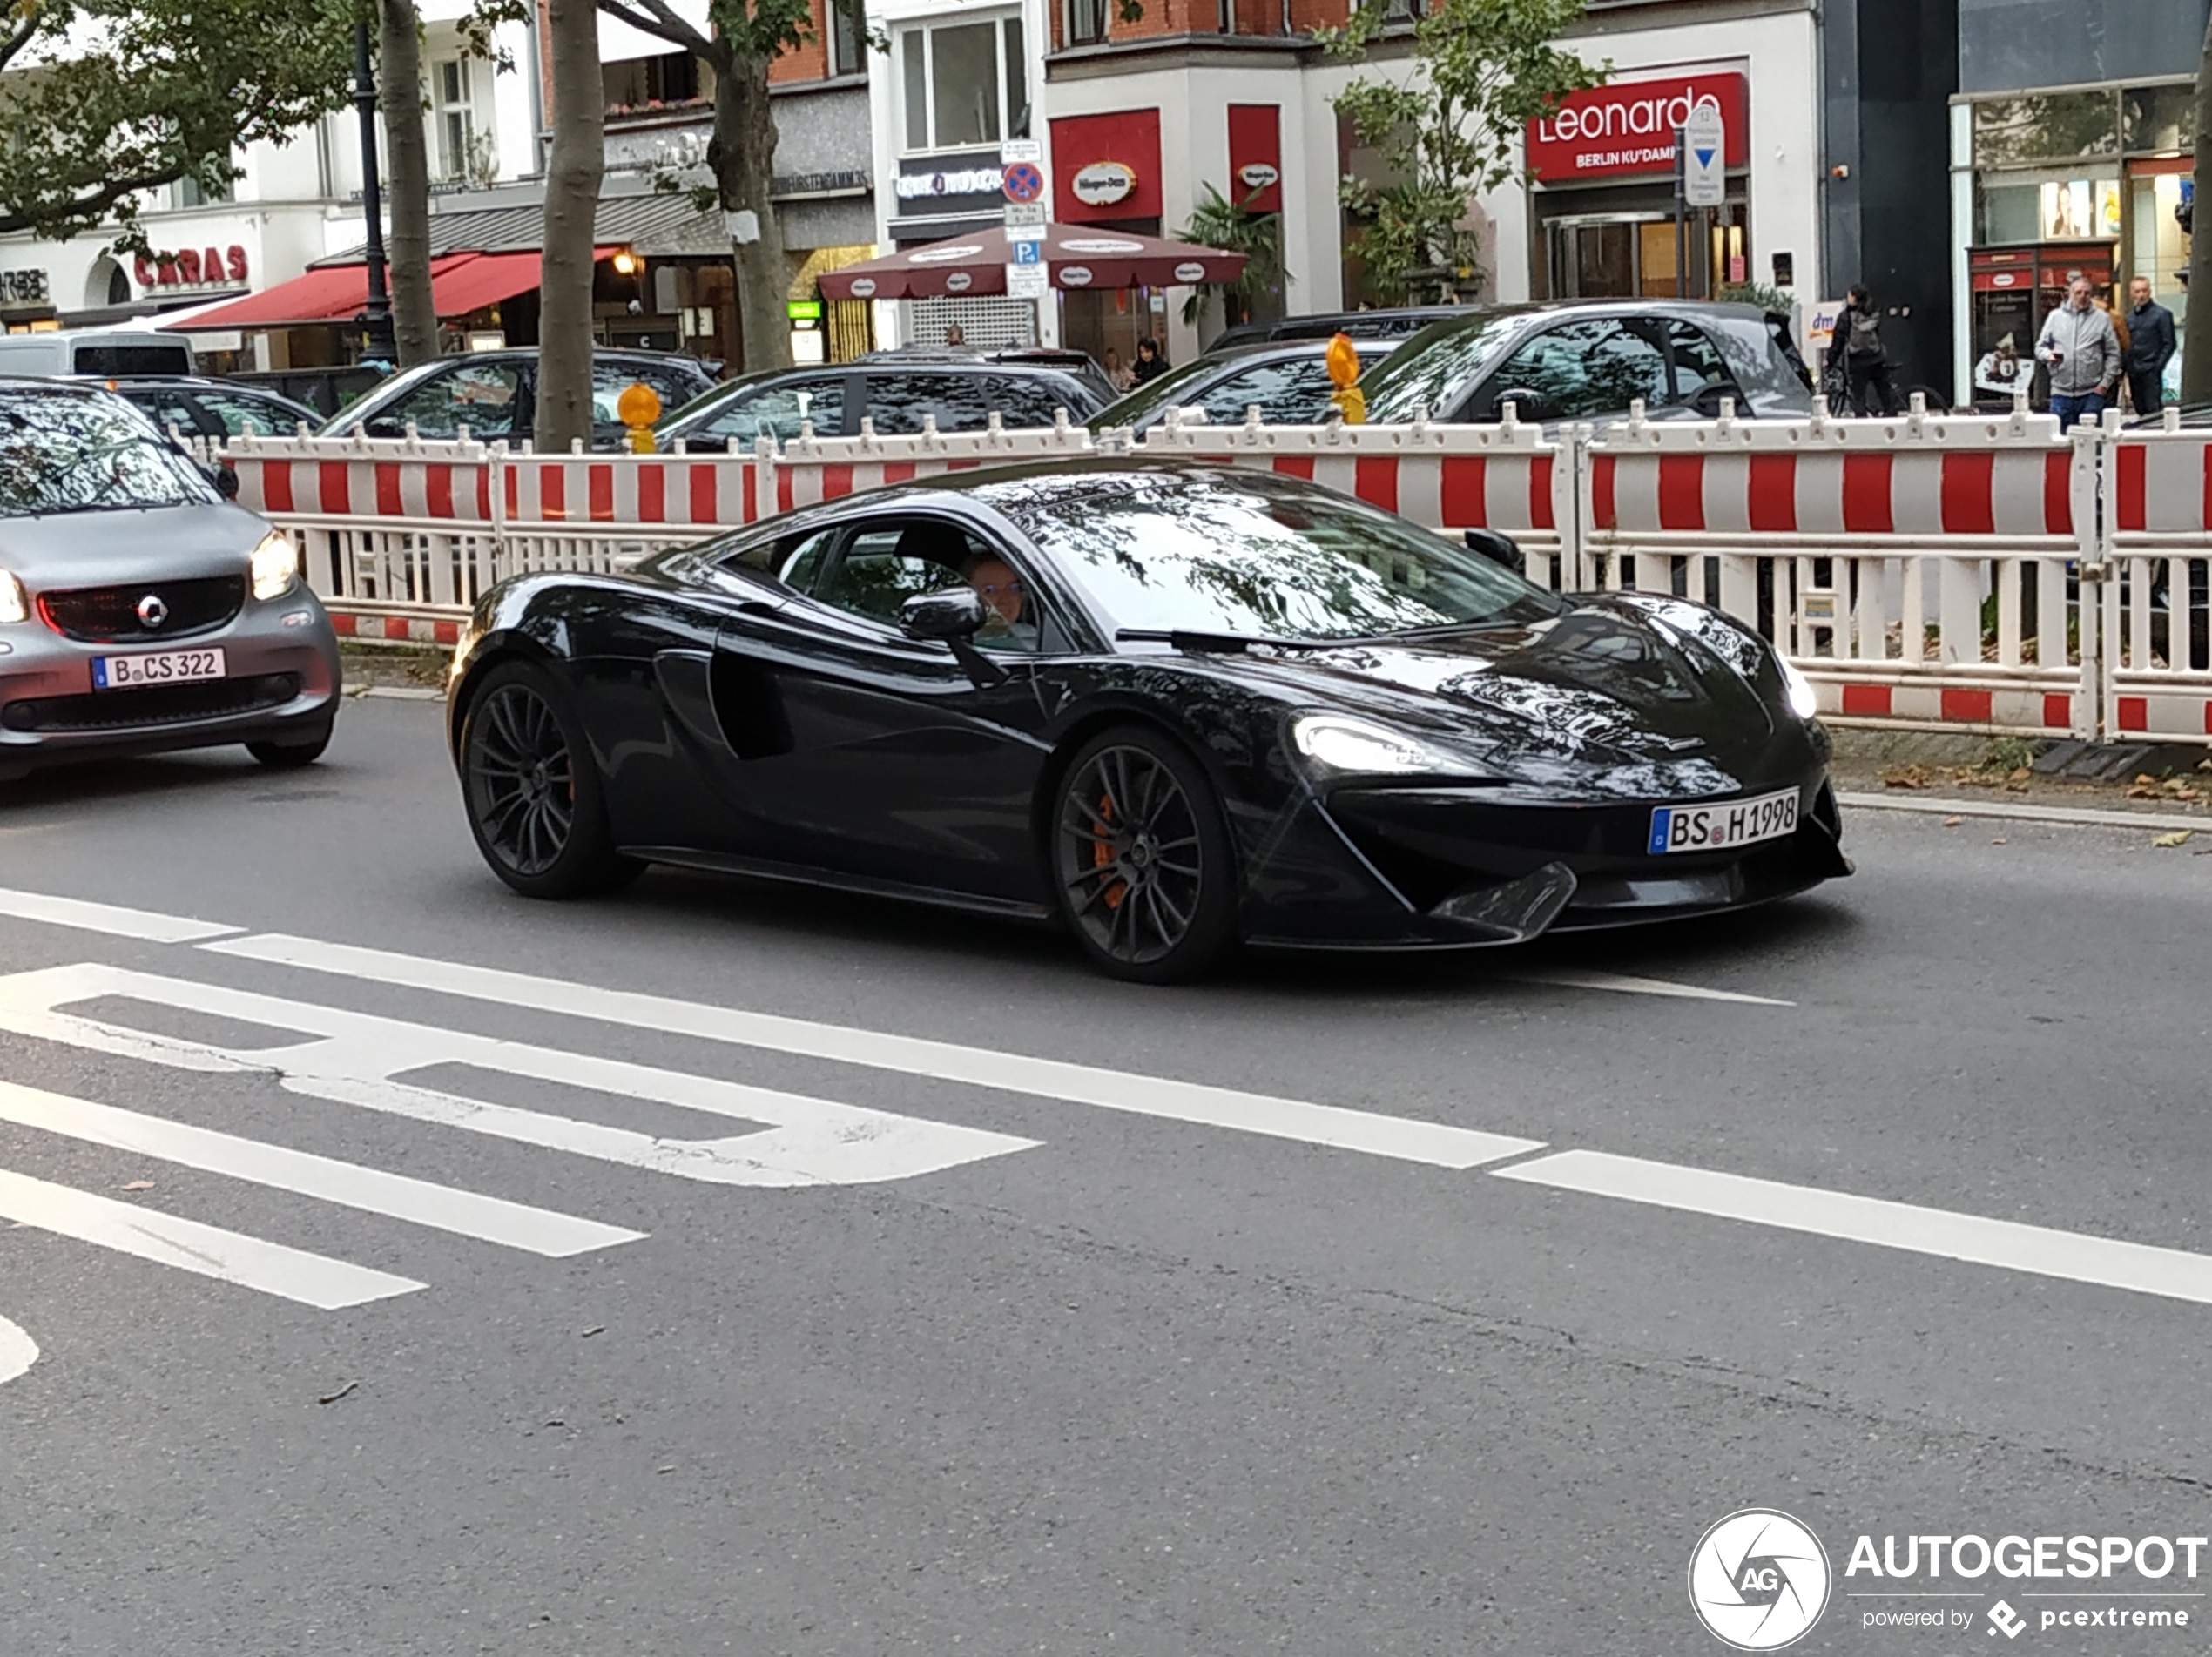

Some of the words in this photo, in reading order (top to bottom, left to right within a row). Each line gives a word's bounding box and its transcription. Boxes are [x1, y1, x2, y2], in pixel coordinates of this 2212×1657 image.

[1576, 152, 1620, 168] BERLIN
[134, 245, 248, 286] CARAS
[1017, 243, 1032, 263] P
[1812, 312, 1834, 330] dm
[114, 659, 130, 683] B
[144, 656, 172, 679] CS
[177, 652, 217, 677] 322
[1670, 811, 1710, 846] BS
